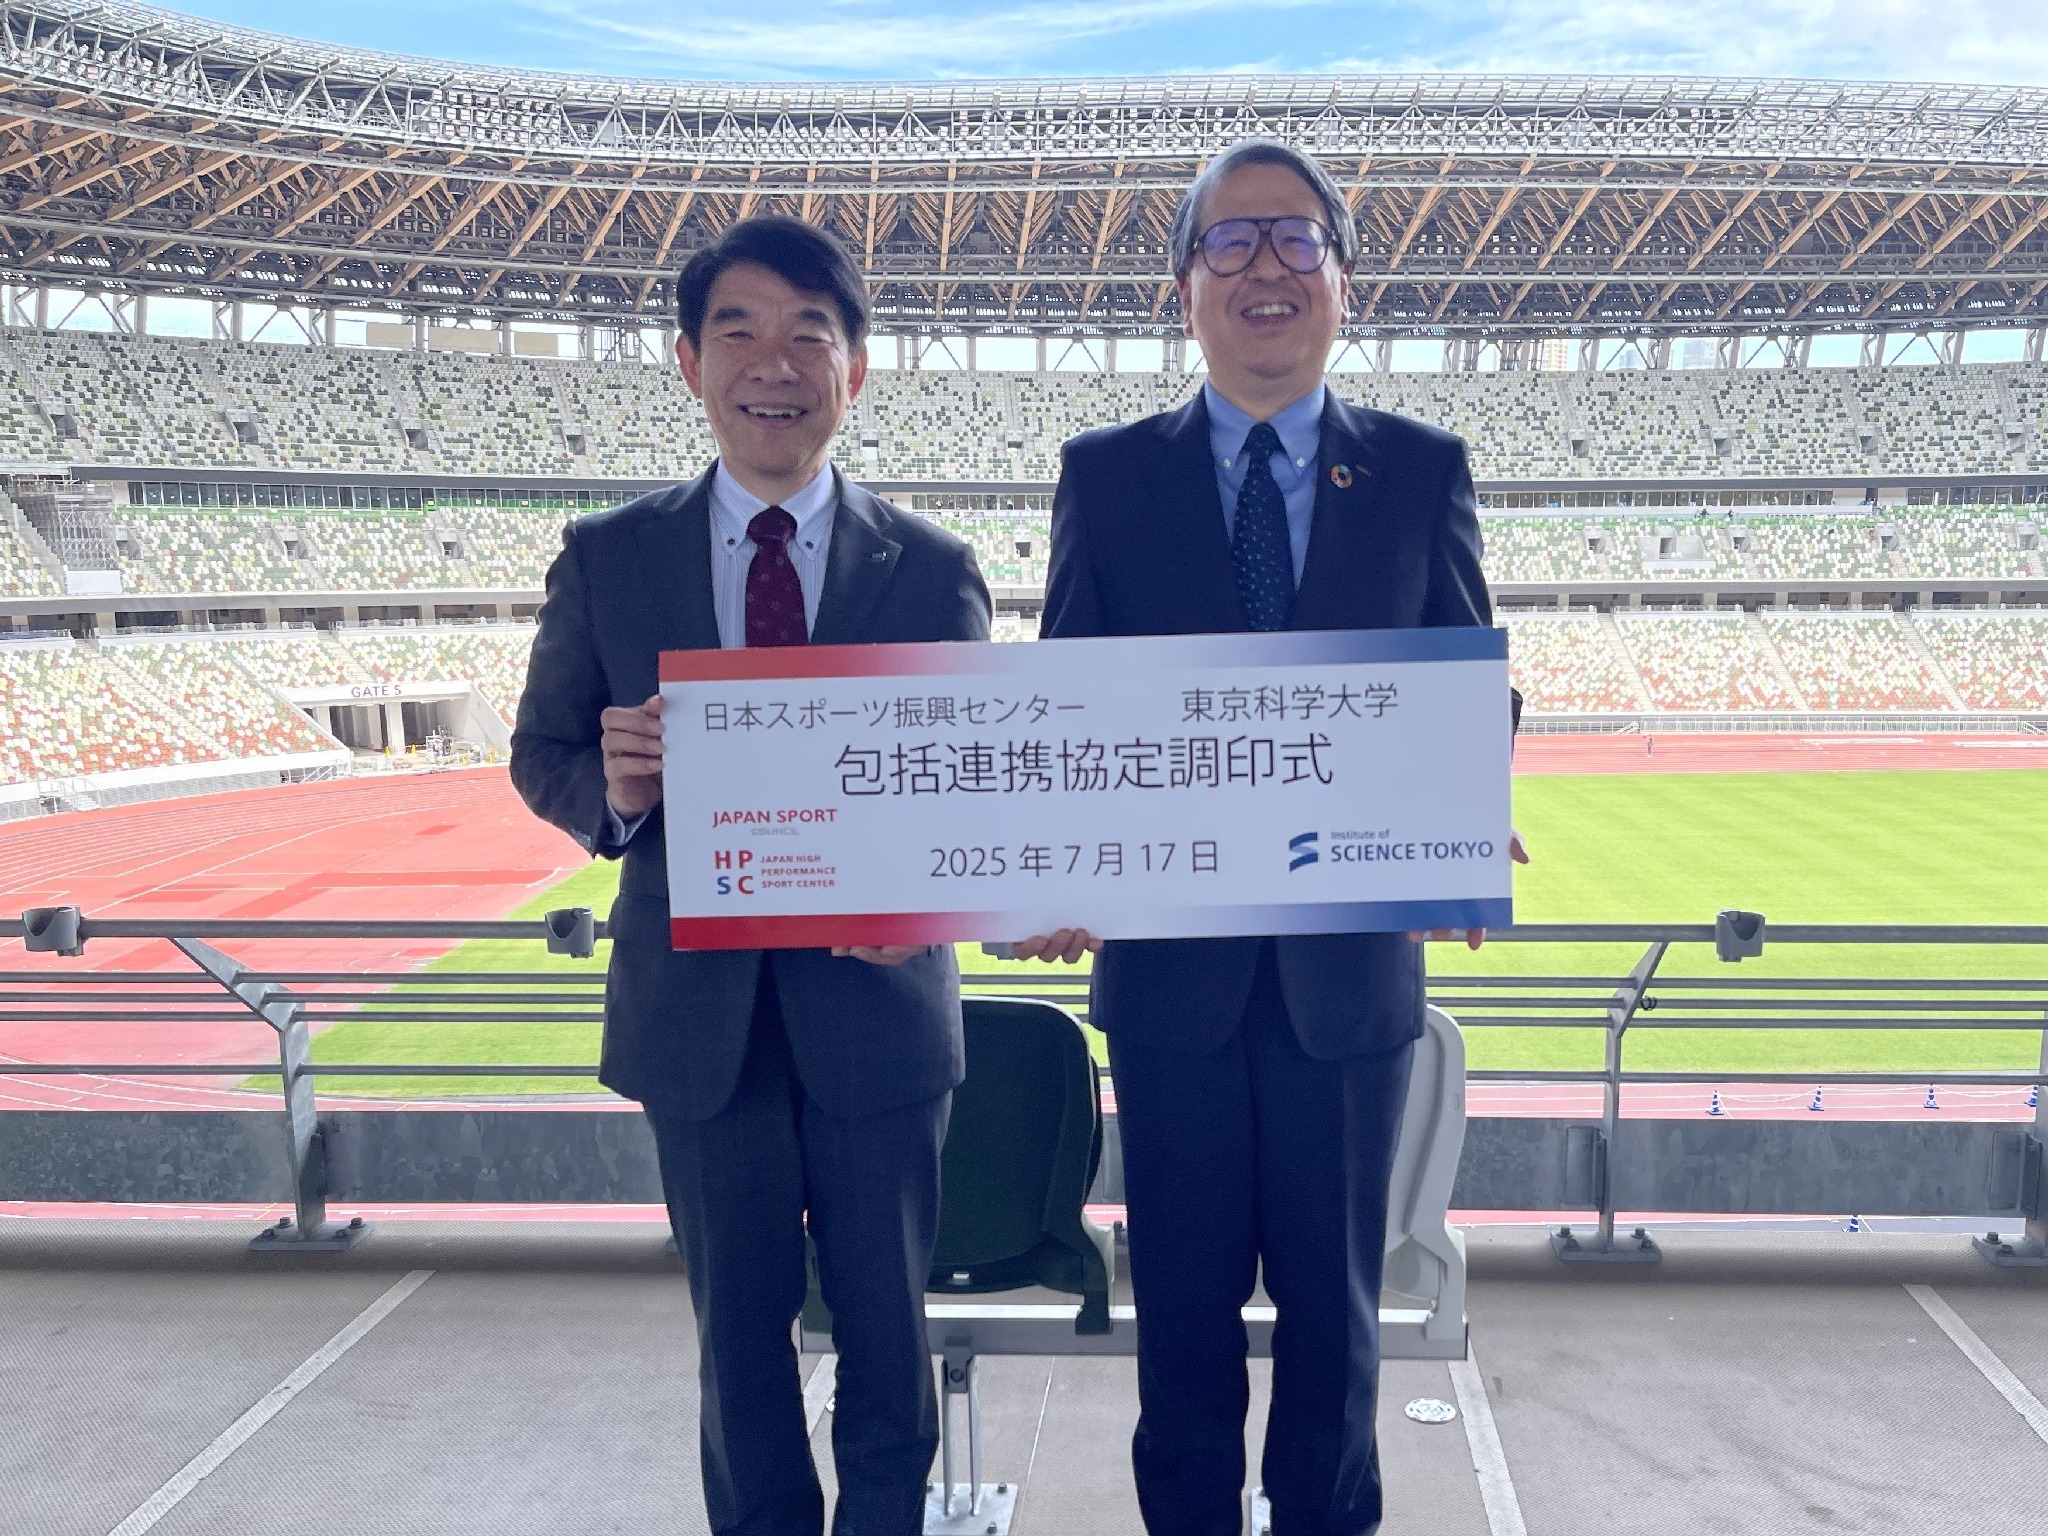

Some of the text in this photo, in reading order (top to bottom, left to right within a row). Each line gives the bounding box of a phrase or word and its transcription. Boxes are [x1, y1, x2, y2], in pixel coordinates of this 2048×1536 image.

[351, 684, 402, 698] GATE 5
[704, 694, 1085, 732] 日本スポーツ振興センター
[1181, 683, 1399, 723] 東京科学大学
[834, 733, 1333, 796] 包括連携協定調印式
[712, 808, 838, 828] JAPAN SPORT
[1330, 829, 1390, 840] Institute of
[930, 846, 1007, 878] 2025
[1330, 841, 1494, 863] SCIENCE TOKYO
[761, 867, 836, 876] PERFORMANCE
[761, 879, 835, 889] SPORT CENTER
